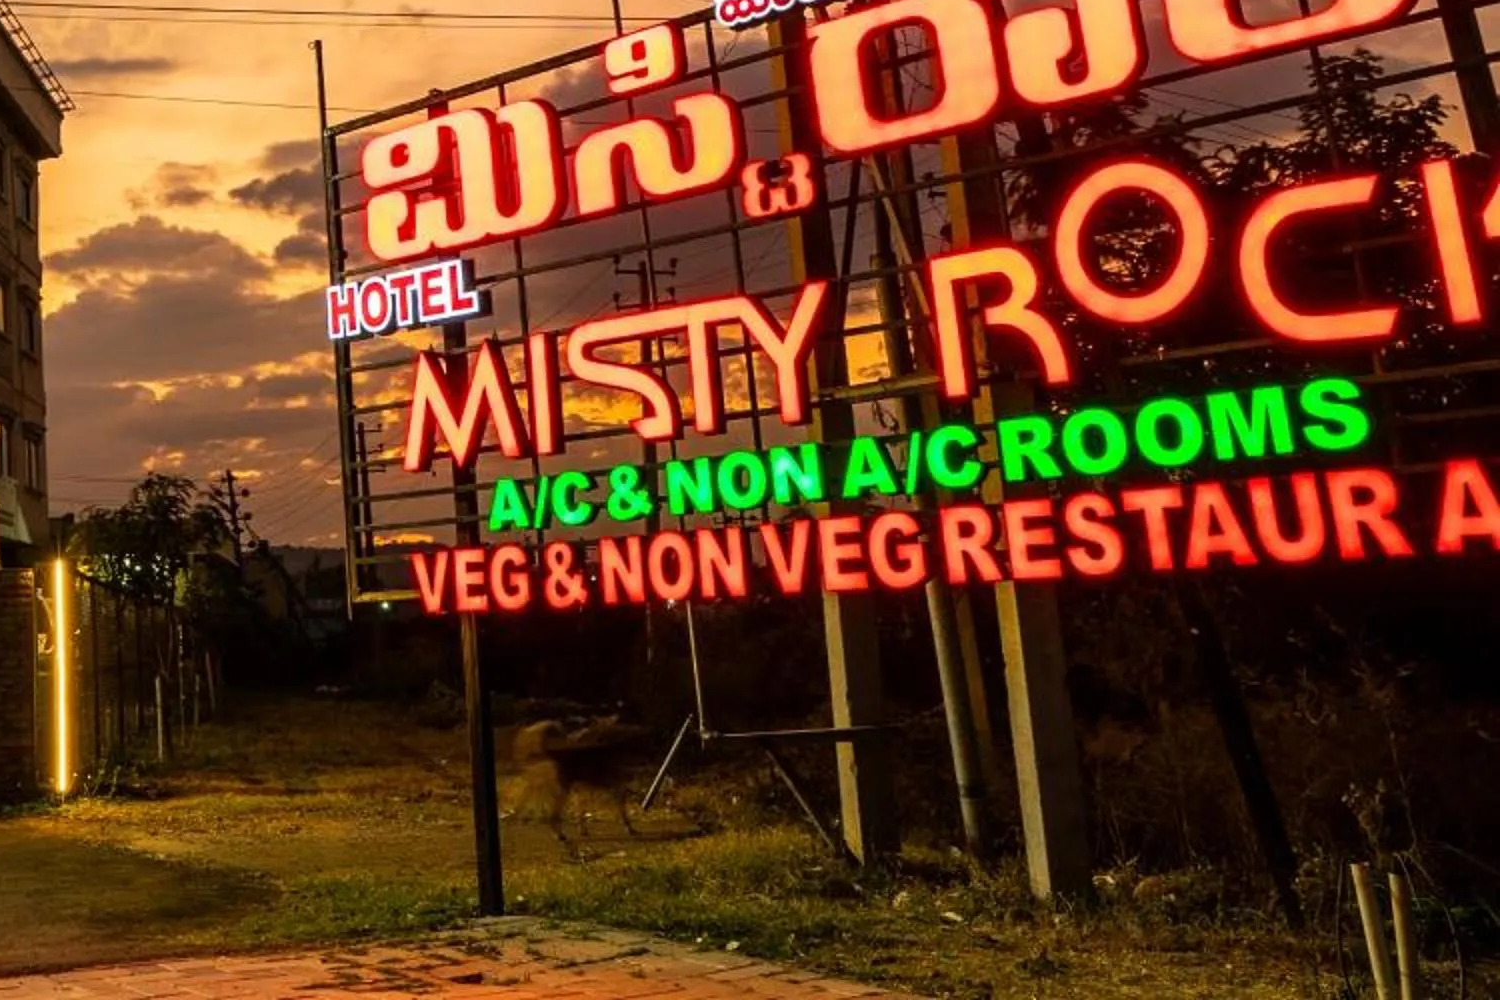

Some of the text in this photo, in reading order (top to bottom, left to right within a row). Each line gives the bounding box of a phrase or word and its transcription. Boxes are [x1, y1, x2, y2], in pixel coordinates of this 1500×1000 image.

[329, 262, 476, 337] HOTEL
[402, 281, 827, 473] MISTY
[488, 377, 1370, 531] A/C & NON A/C ROOMS
[411, 545, 529, 613] VEG
[545, 541, 587, 608] &
[600, 528, 746, 604] NON
[760, 512, 926, 593] VEG
